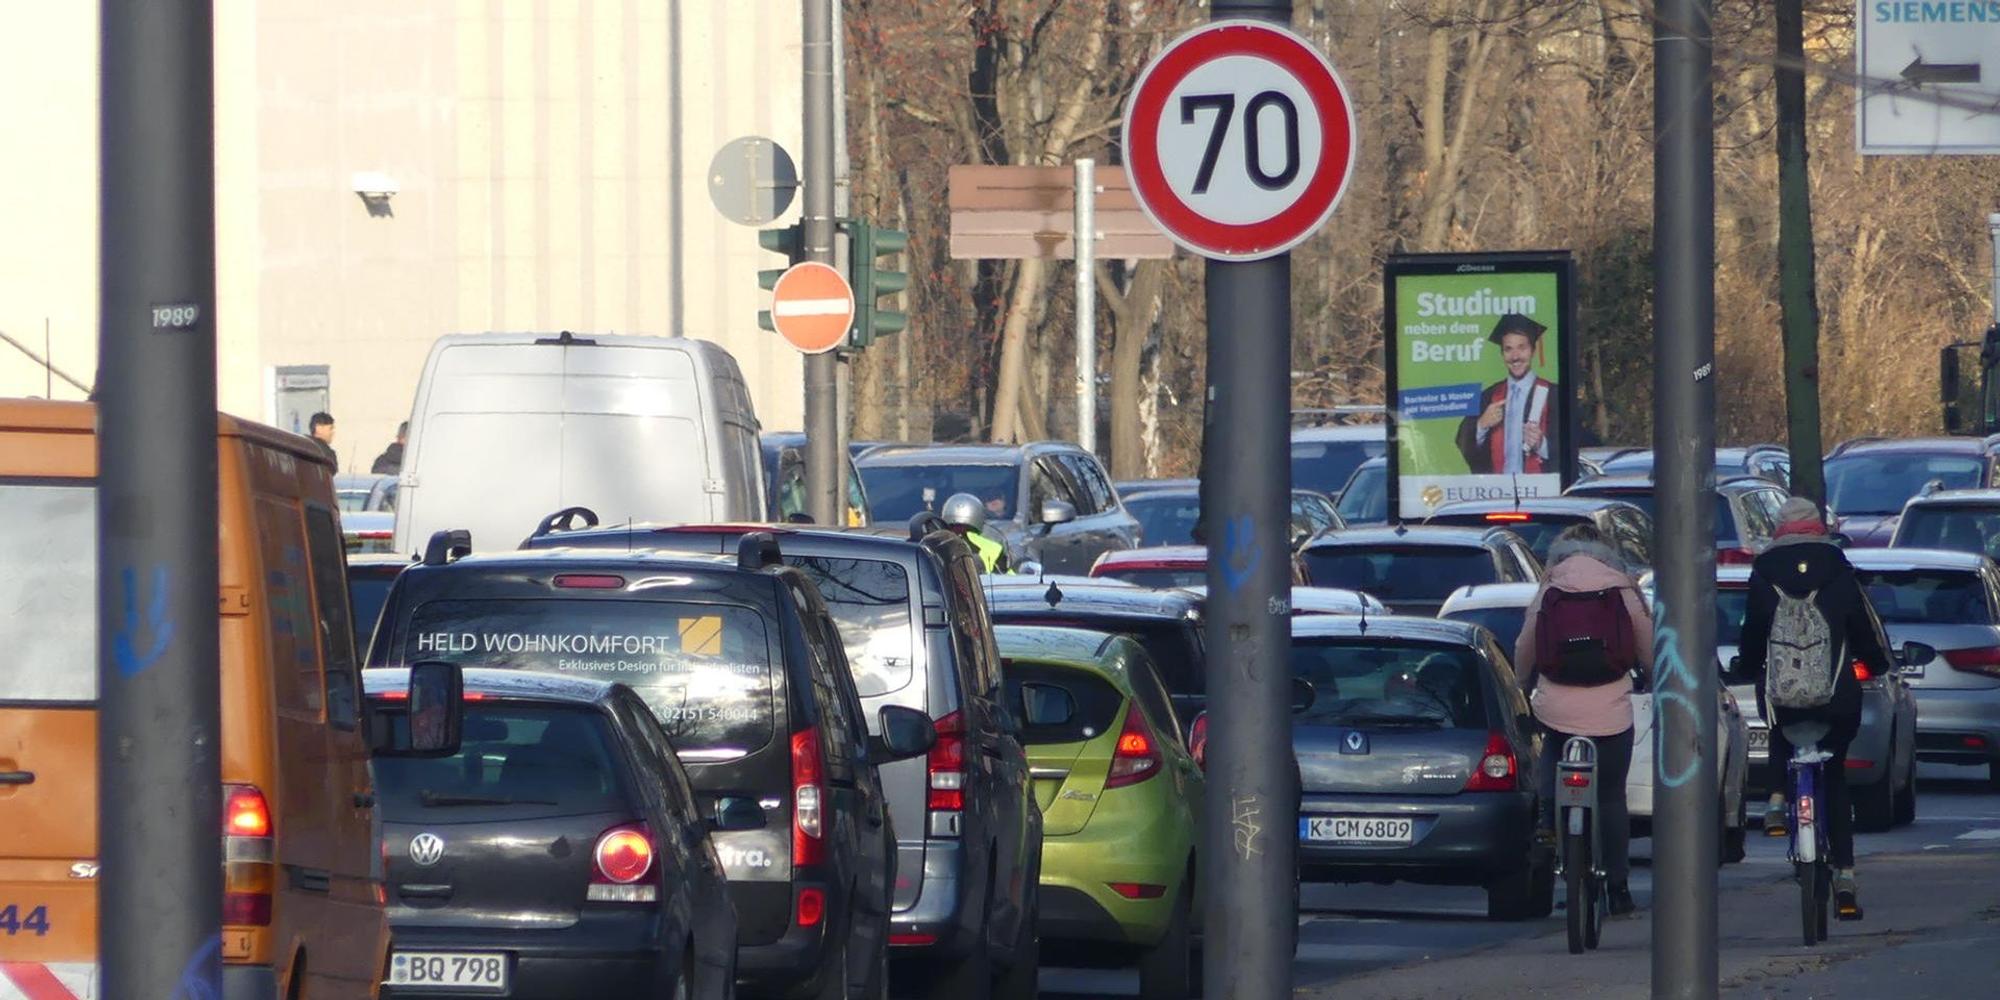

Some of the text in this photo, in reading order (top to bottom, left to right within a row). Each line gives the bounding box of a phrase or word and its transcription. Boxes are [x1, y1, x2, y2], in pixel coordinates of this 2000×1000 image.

[1875, 0, 2000, 22] SIEMENS
[1180, 90, 1300, 195] 70
[1417, 288, 1537, 317] Studium
[153, 308, 195, 327] 1989
[1404, 321, 1479, 335] neben dem
[1411, 338, 1484, 362] Beruf
[1693, 363, 1711, 380] 1989
[418, 633, 669, 654] HELD WOHNKOMFORT
[559, 660, 615, 671] Exklusives
[618, 661, 656, 674] Design
[663, 706, 757, 721] 02151 540044
[1311, 821, 1410, 838] K CM 6809
[410, 957, 500, 982] BQ 798
